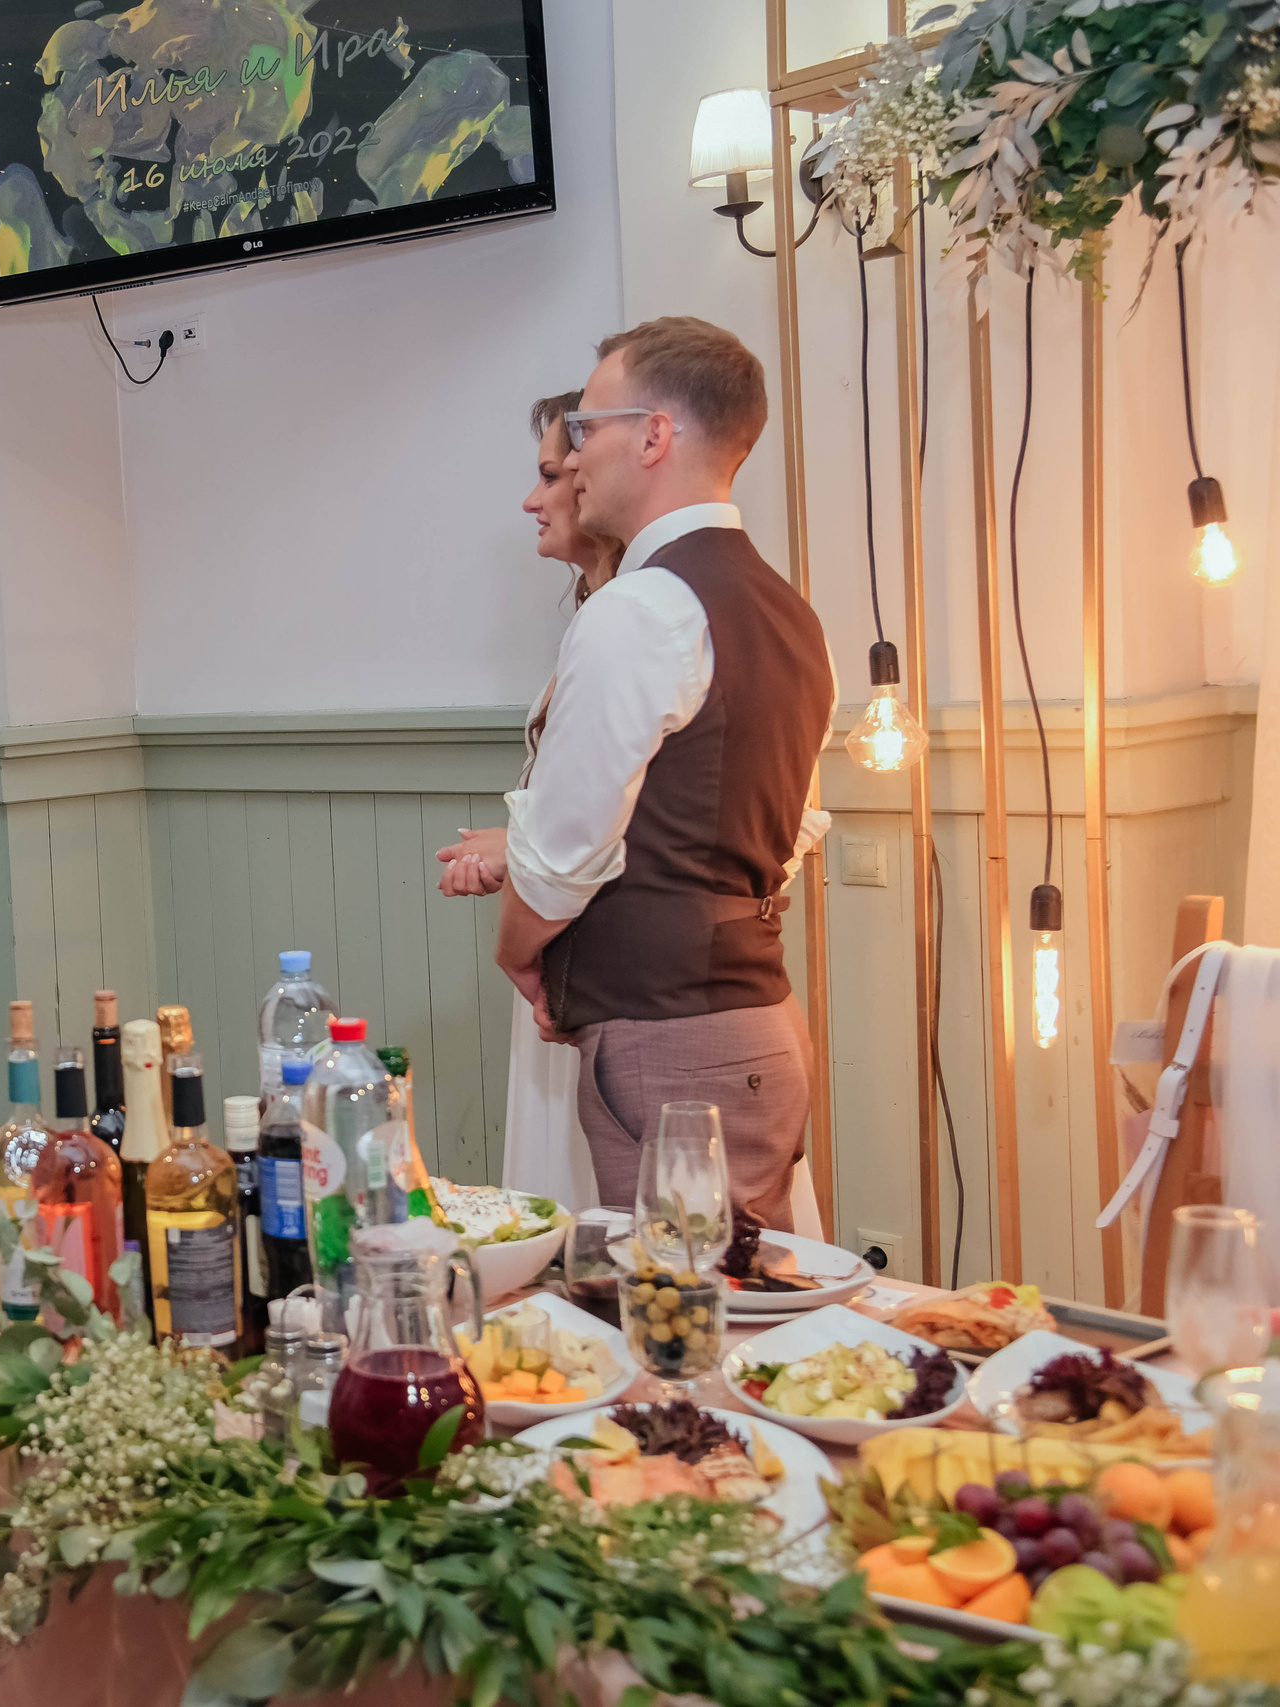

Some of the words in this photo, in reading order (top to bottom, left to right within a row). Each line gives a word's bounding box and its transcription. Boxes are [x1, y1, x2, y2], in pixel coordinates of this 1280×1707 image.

[95, 65, 226, 117] Илья
[240, 54, 281, 85] и
[295, 29, 405, 78] Ира
[123, 164, 165, 193] 16
[178, 145, 278, 184] июля
[287, 121, 382, 165] 2022
[182, 179, 321, 213] #KeepCalmAndBeTrofimovy
[253, 240, 263, 248] LG
